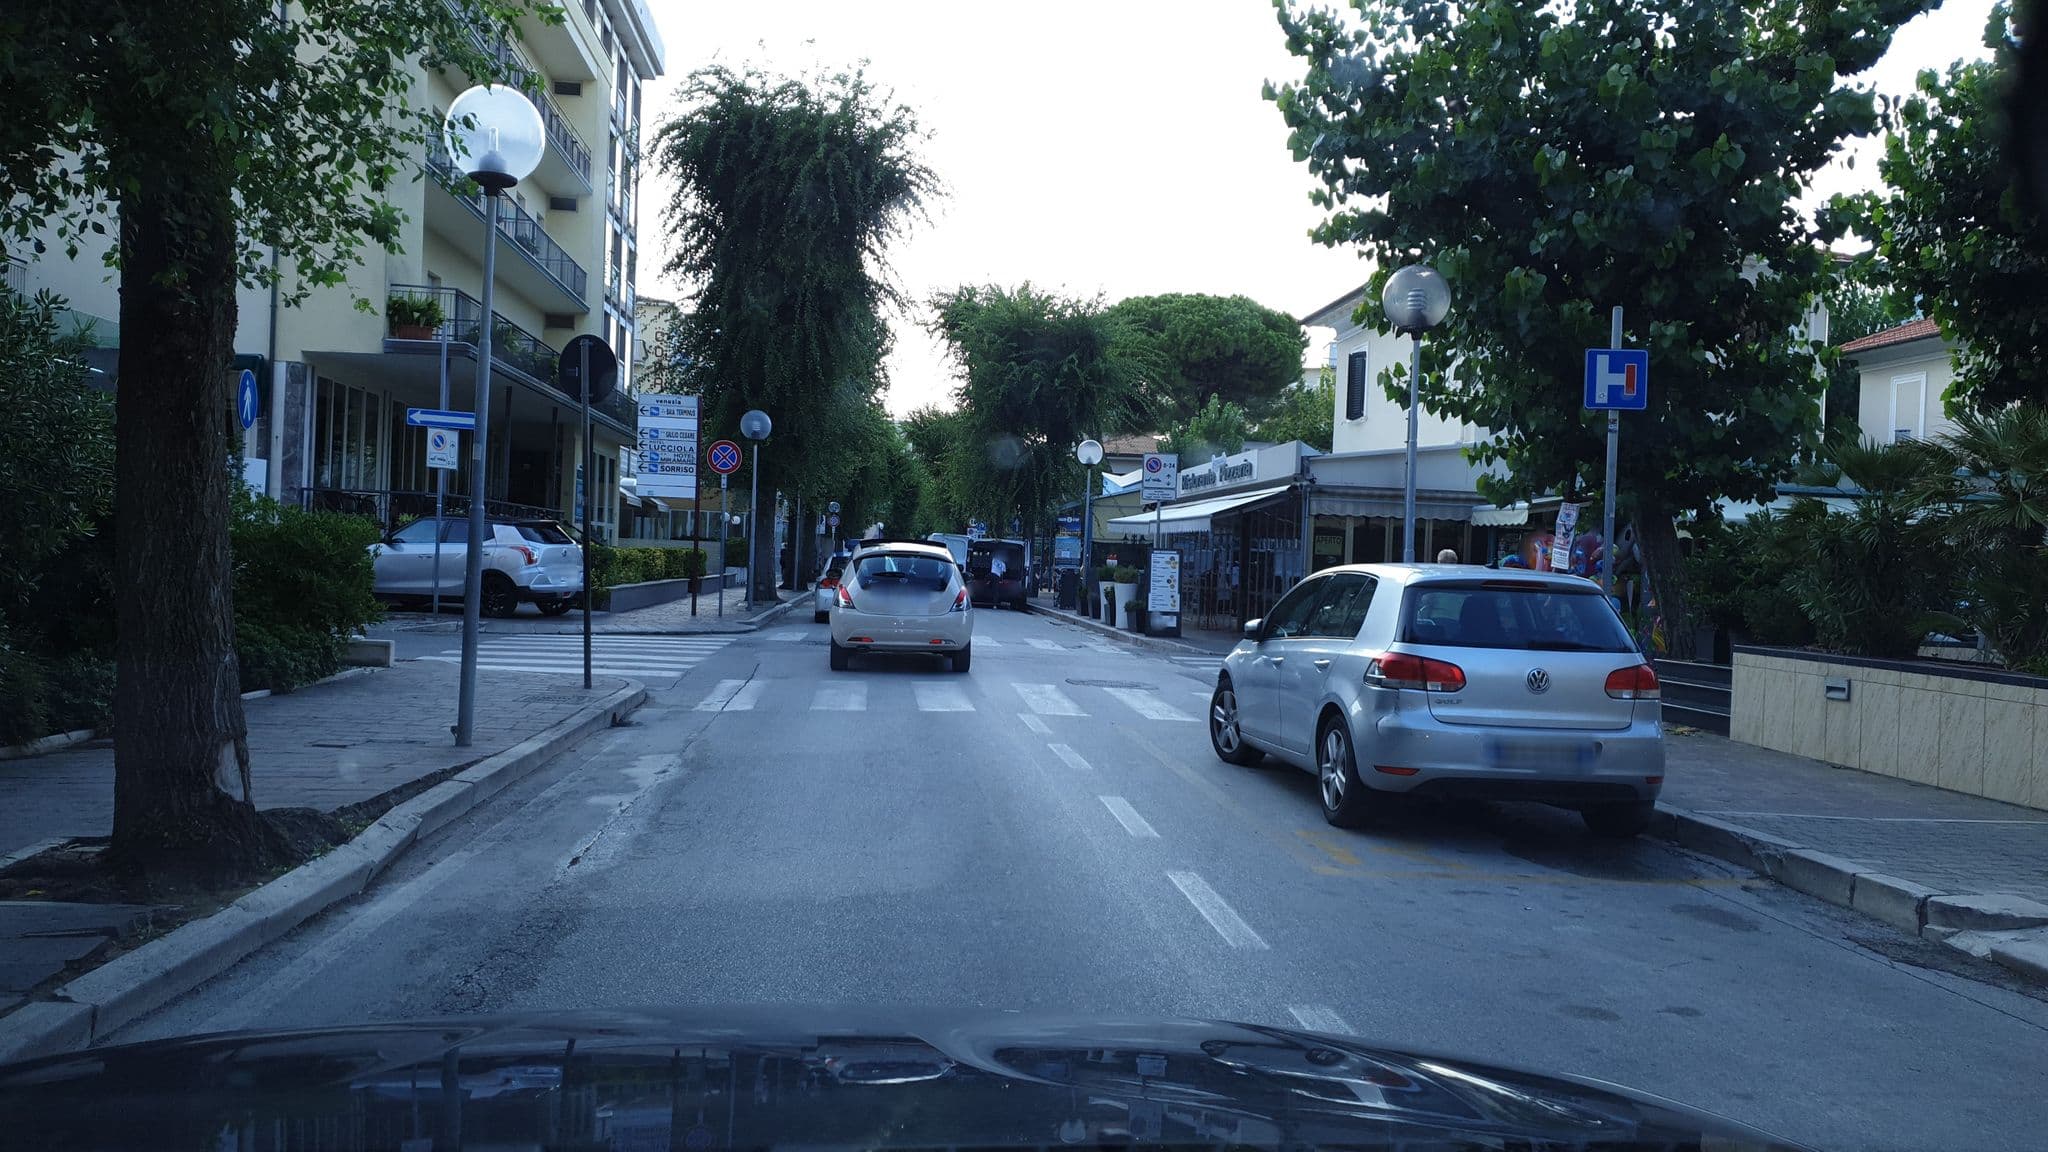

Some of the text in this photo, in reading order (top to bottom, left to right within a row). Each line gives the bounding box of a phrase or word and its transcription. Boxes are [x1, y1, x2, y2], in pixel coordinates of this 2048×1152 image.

[649, 444, 695, 452] LUCCIOLA
[660, 465, 695, 474] SORRISO
[1182, 459, 1253, 490] Ristorante Pizzeria
